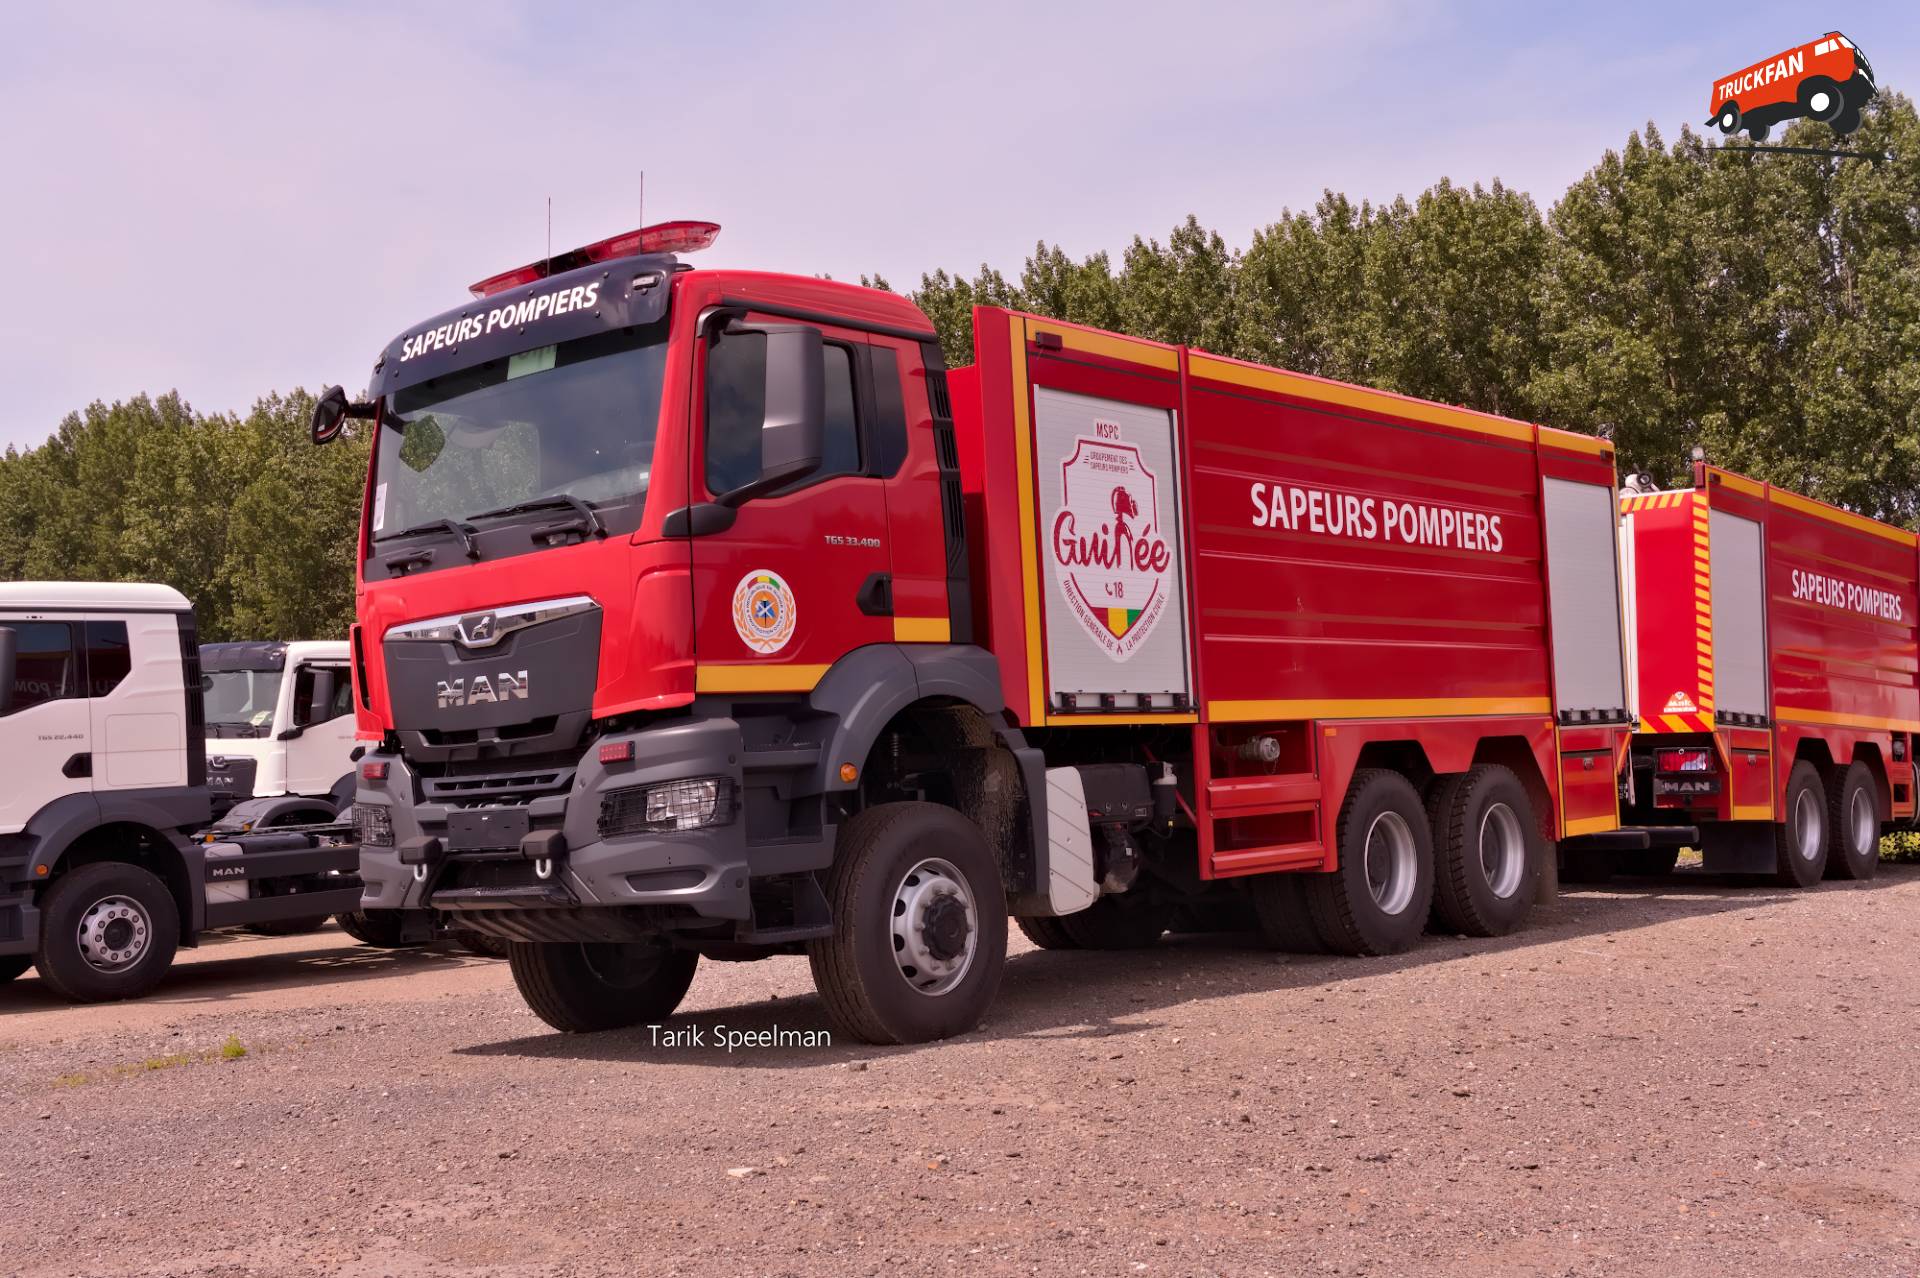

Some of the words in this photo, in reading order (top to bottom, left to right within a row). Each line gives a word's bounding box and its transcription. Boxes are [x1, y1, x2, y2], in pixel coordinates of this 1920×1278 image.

[400, 313, 485, 362] SAPEURS
[485, 282, 600, 334] POMPIERS
[1096, 422, 1119, 440] MSPC
[1251, 482, 1378, 539] SAPEURS
[1383, 500, 1503, 553] POMPIERS
[824, 535, 844, 545] TGS
[845, 536, 881, 548] 33.400
[1053, 511, 1170, 573] Guinée
[1113, 582, 1124, 599] 18
[1791, 569, 1846, 609] SAPEURS
[1847, 583, 1902, 621] POMPIERS
[1063, 580, 1086, 618] DIRECTION
[1125, 640, 1134, 651] LA
[1131, 612, 1156, 646] PROTECTION
[437, 670, 529, 708] MAN
[1664, 782, 1710, 791] MAN
[212, 867, 245, 877] MAN
